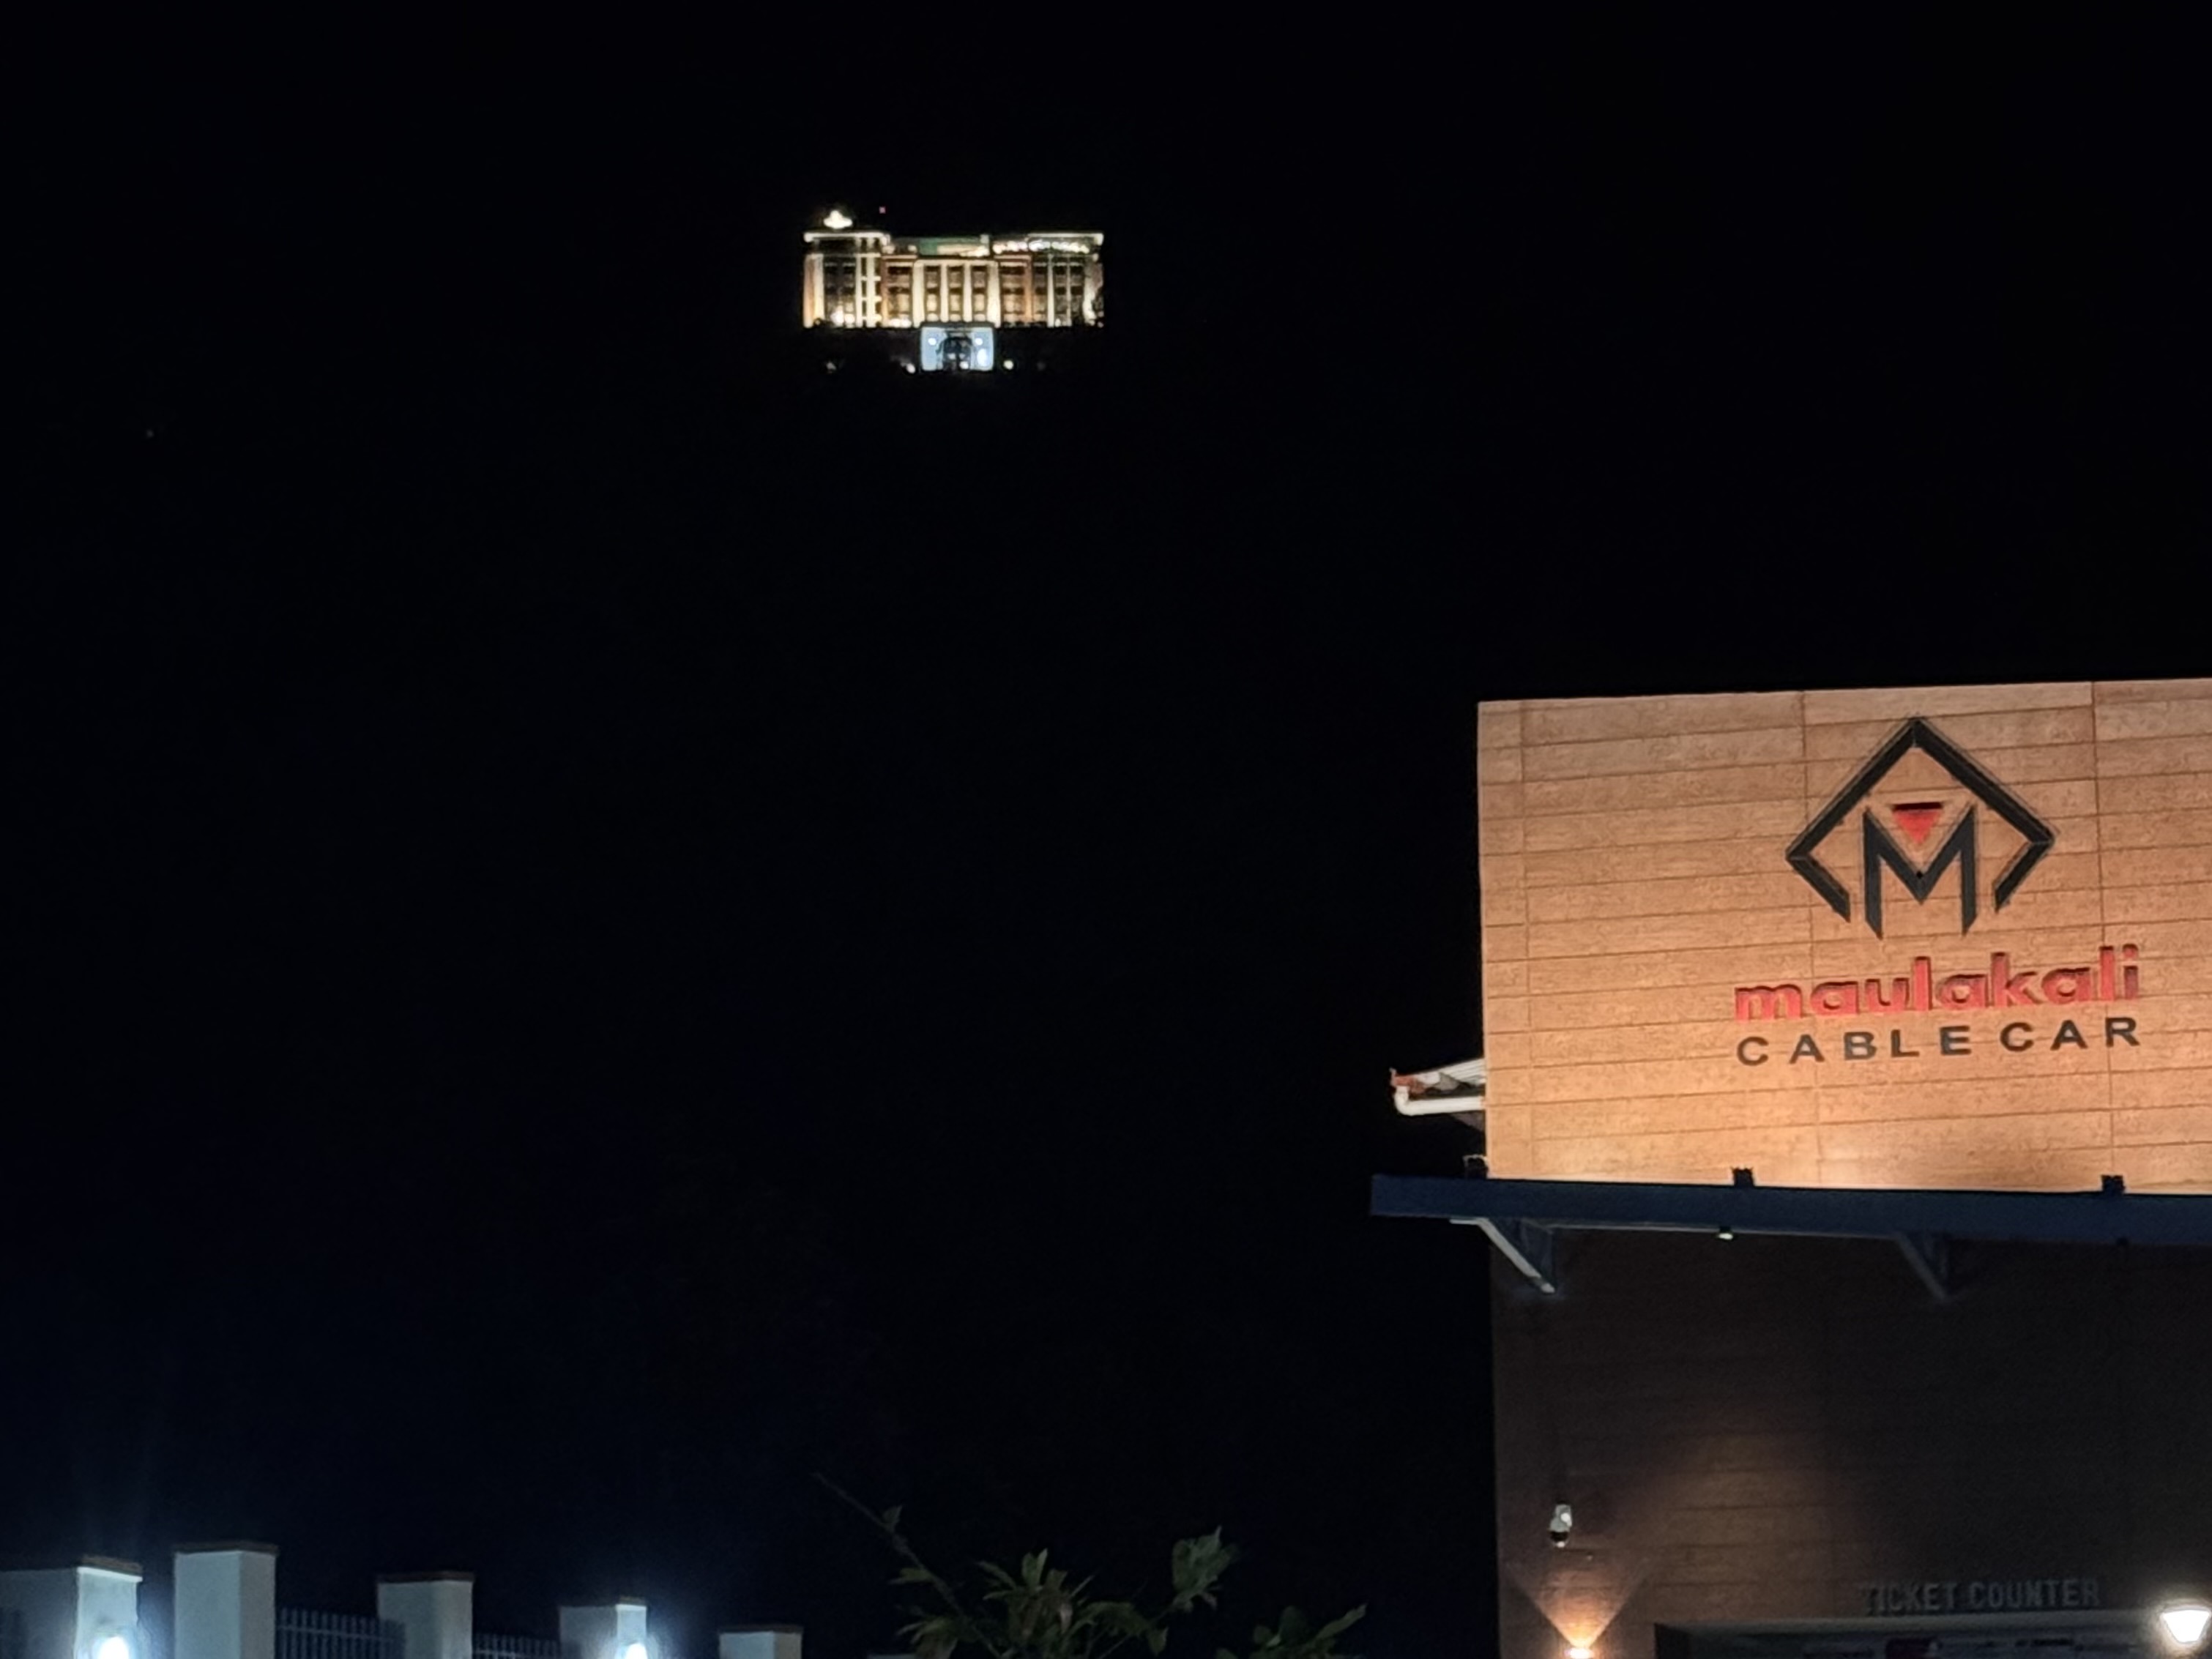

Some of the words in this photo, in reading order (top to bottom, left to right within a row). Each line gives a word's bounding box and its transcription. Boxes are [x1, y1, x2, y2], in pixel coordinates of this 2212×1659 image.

[1734, 944, 2140, 1020] maulakali
[1736, 1026, 1972, 1066] CABLE
[1999, 1017, 2140, 1052] CAR
[1861, 1580, 1958, 1615] TICKET
[1968, 1577, 2101, 1609] COUNTER
